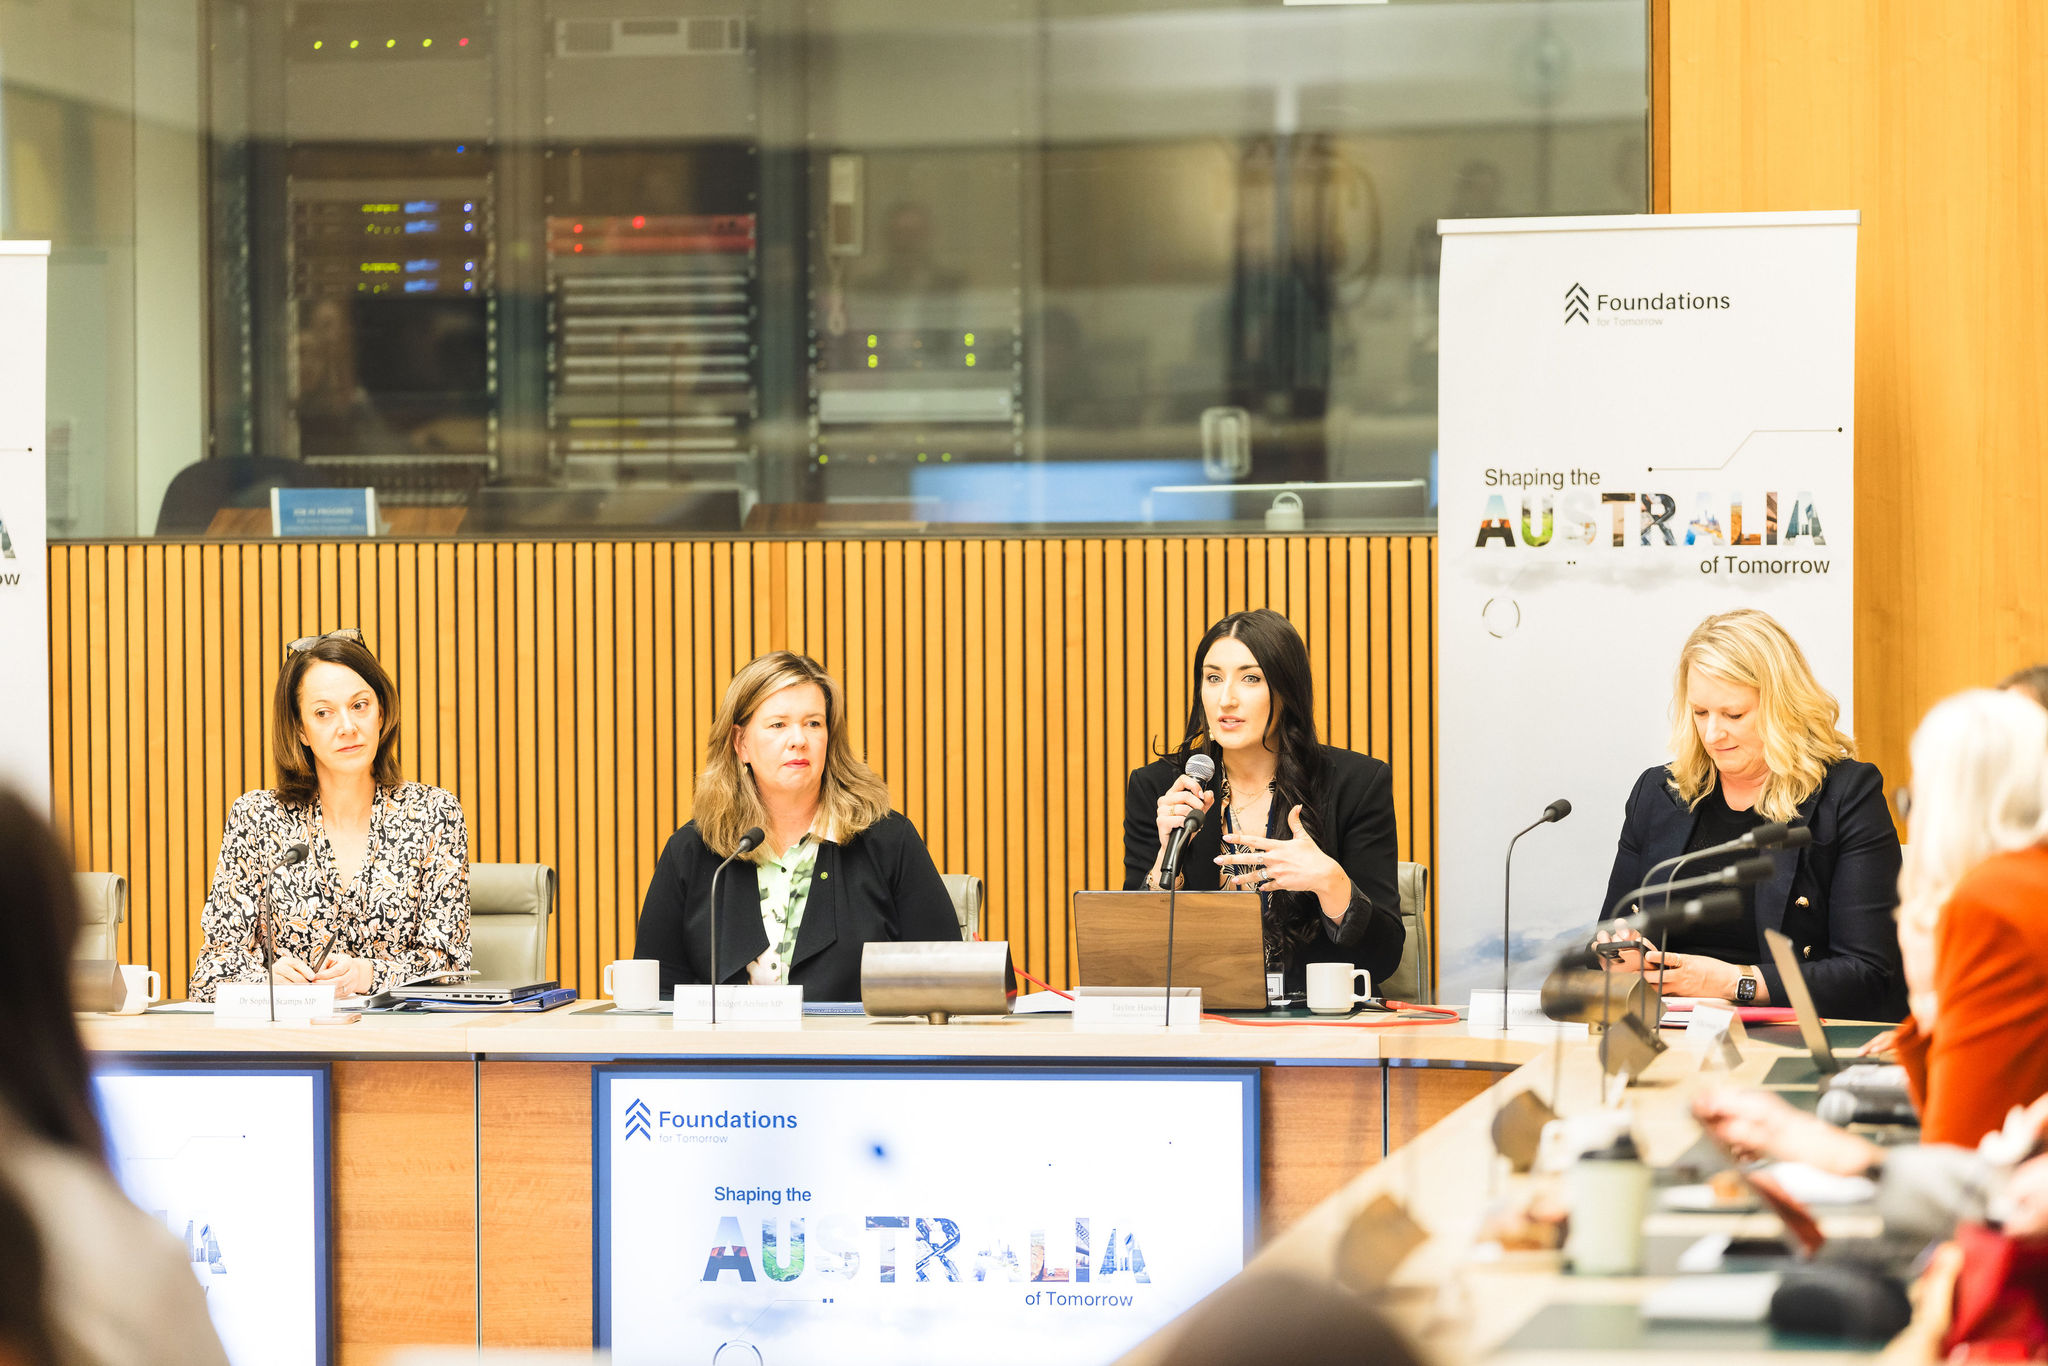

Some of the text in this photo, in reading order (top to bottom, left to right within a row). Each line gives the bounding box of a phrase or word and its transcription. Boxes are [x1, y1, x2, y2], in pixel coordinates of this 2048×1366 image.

[1598, 292, 1731, 311] Foundations
[1596, 316, 1664, 327] for Tomorrow
[1485, 467, 1601, 491] Shaping the
[1474, 490, 1828, 548] AUSTRALIA
[1700, 555, 1831, 575] of Tomorrow
[250, 997, 270, 1006] Sophi
[659, 1109, 798, 1129] Foundations
[658, 1132, 729, 1143] for Tomorrow
[714, 1187, 812, 1206] Shaping the
[702, 1215, 1152, 1284] AUSTRALIA
[1025, 1291, 1134, 1306] of Tomorrow
